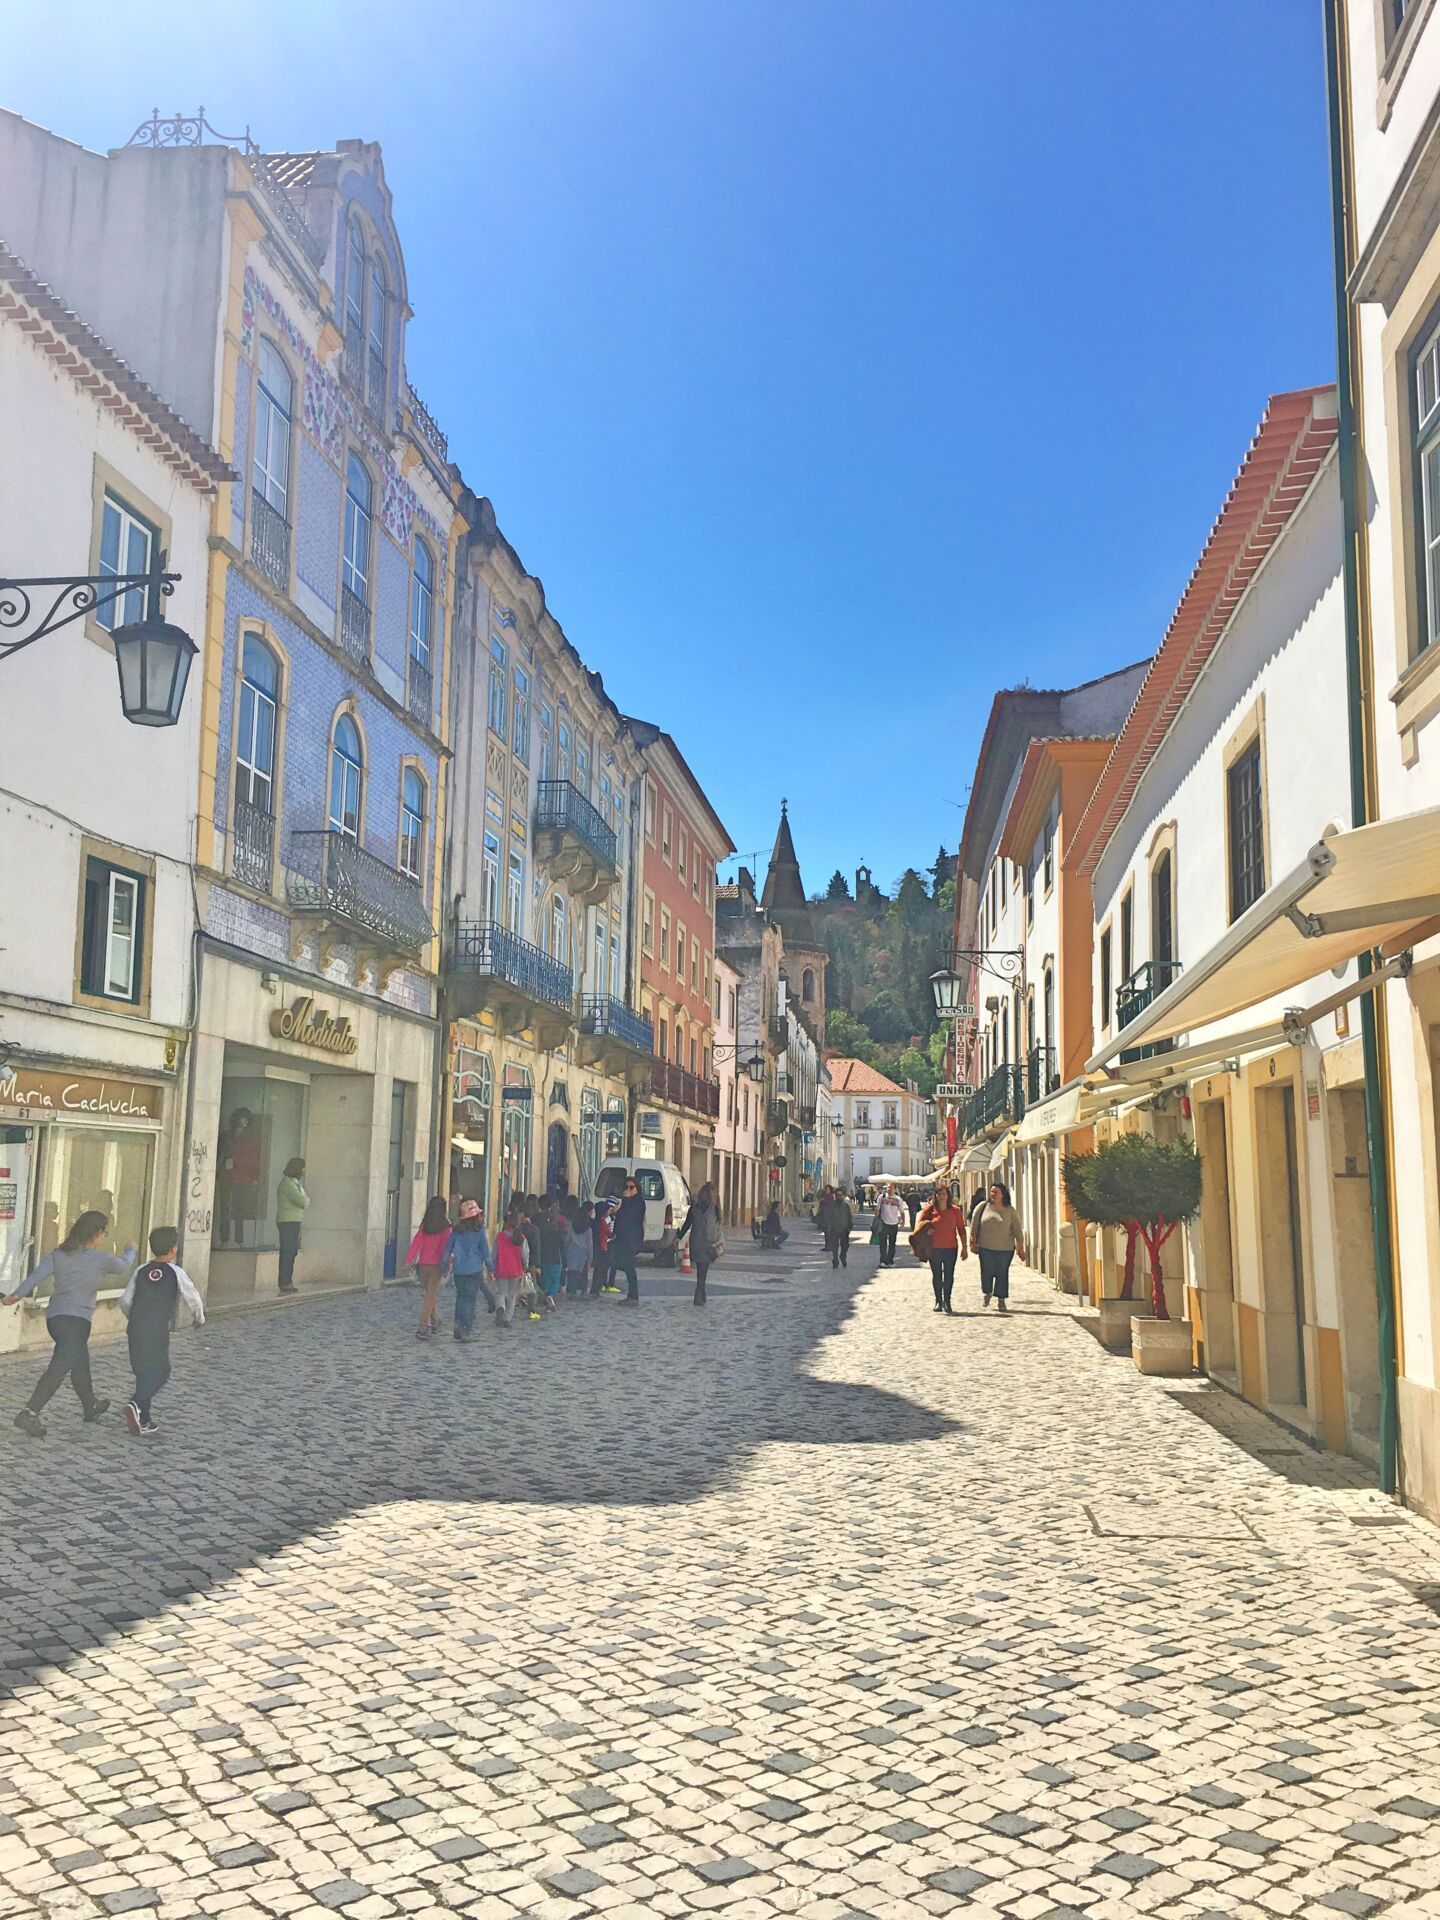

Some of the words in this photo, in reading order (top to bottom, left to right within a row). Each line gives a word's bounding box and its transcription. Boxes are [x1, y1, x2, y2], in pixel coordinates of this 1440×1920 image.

[274, 997, 359, 1055] Moditalia
[956, 1018, 965, 1083] RESIDENCIAL
[0, 1072, 54, 1107] Maria
[62, 1083, 149, 1117] Cachucha
